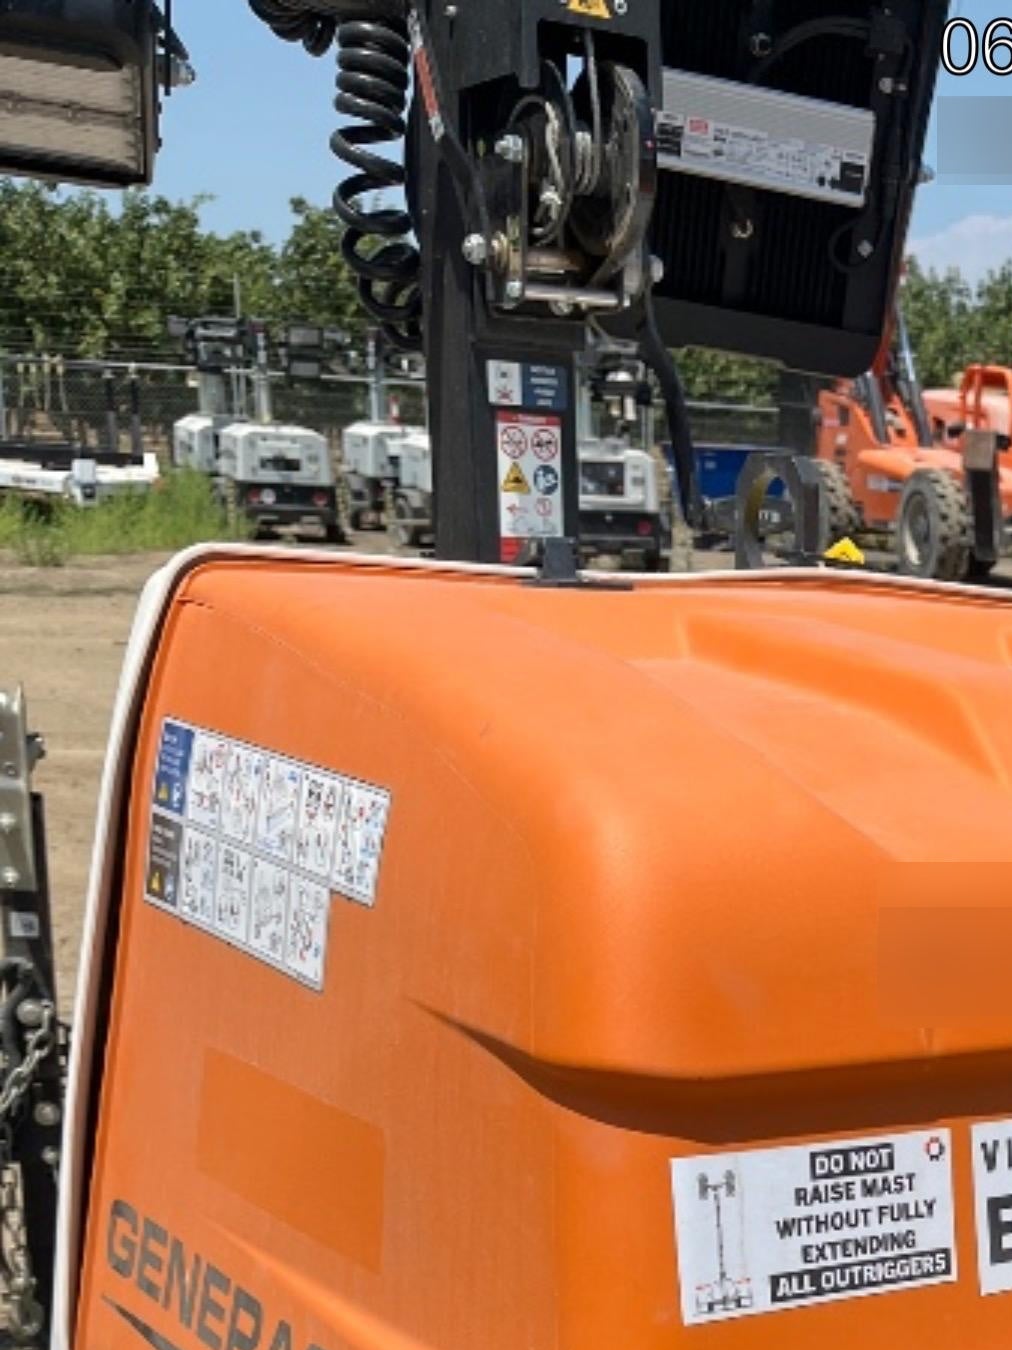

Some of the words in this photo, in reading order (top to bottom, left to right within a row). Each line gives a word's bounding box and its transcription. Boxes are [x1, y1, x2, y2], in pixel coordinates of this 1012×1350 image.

[814, 1155, 844, 1175] DO
[850, 1149, 892, 1170] NOT
[794, 1181, 856, 1207] RAISE
[860, 1173, 916, 1198] MAST
[775, 1207, 872, 1240] WITHOUT
[878, 1199, 937, 1225] FULLY
[801, 1230, 917, 1264] EXTENDING
[776, 1277, 817, 1298] ALL
[820, 1253, 947, 1291] OUTRIGGERS
